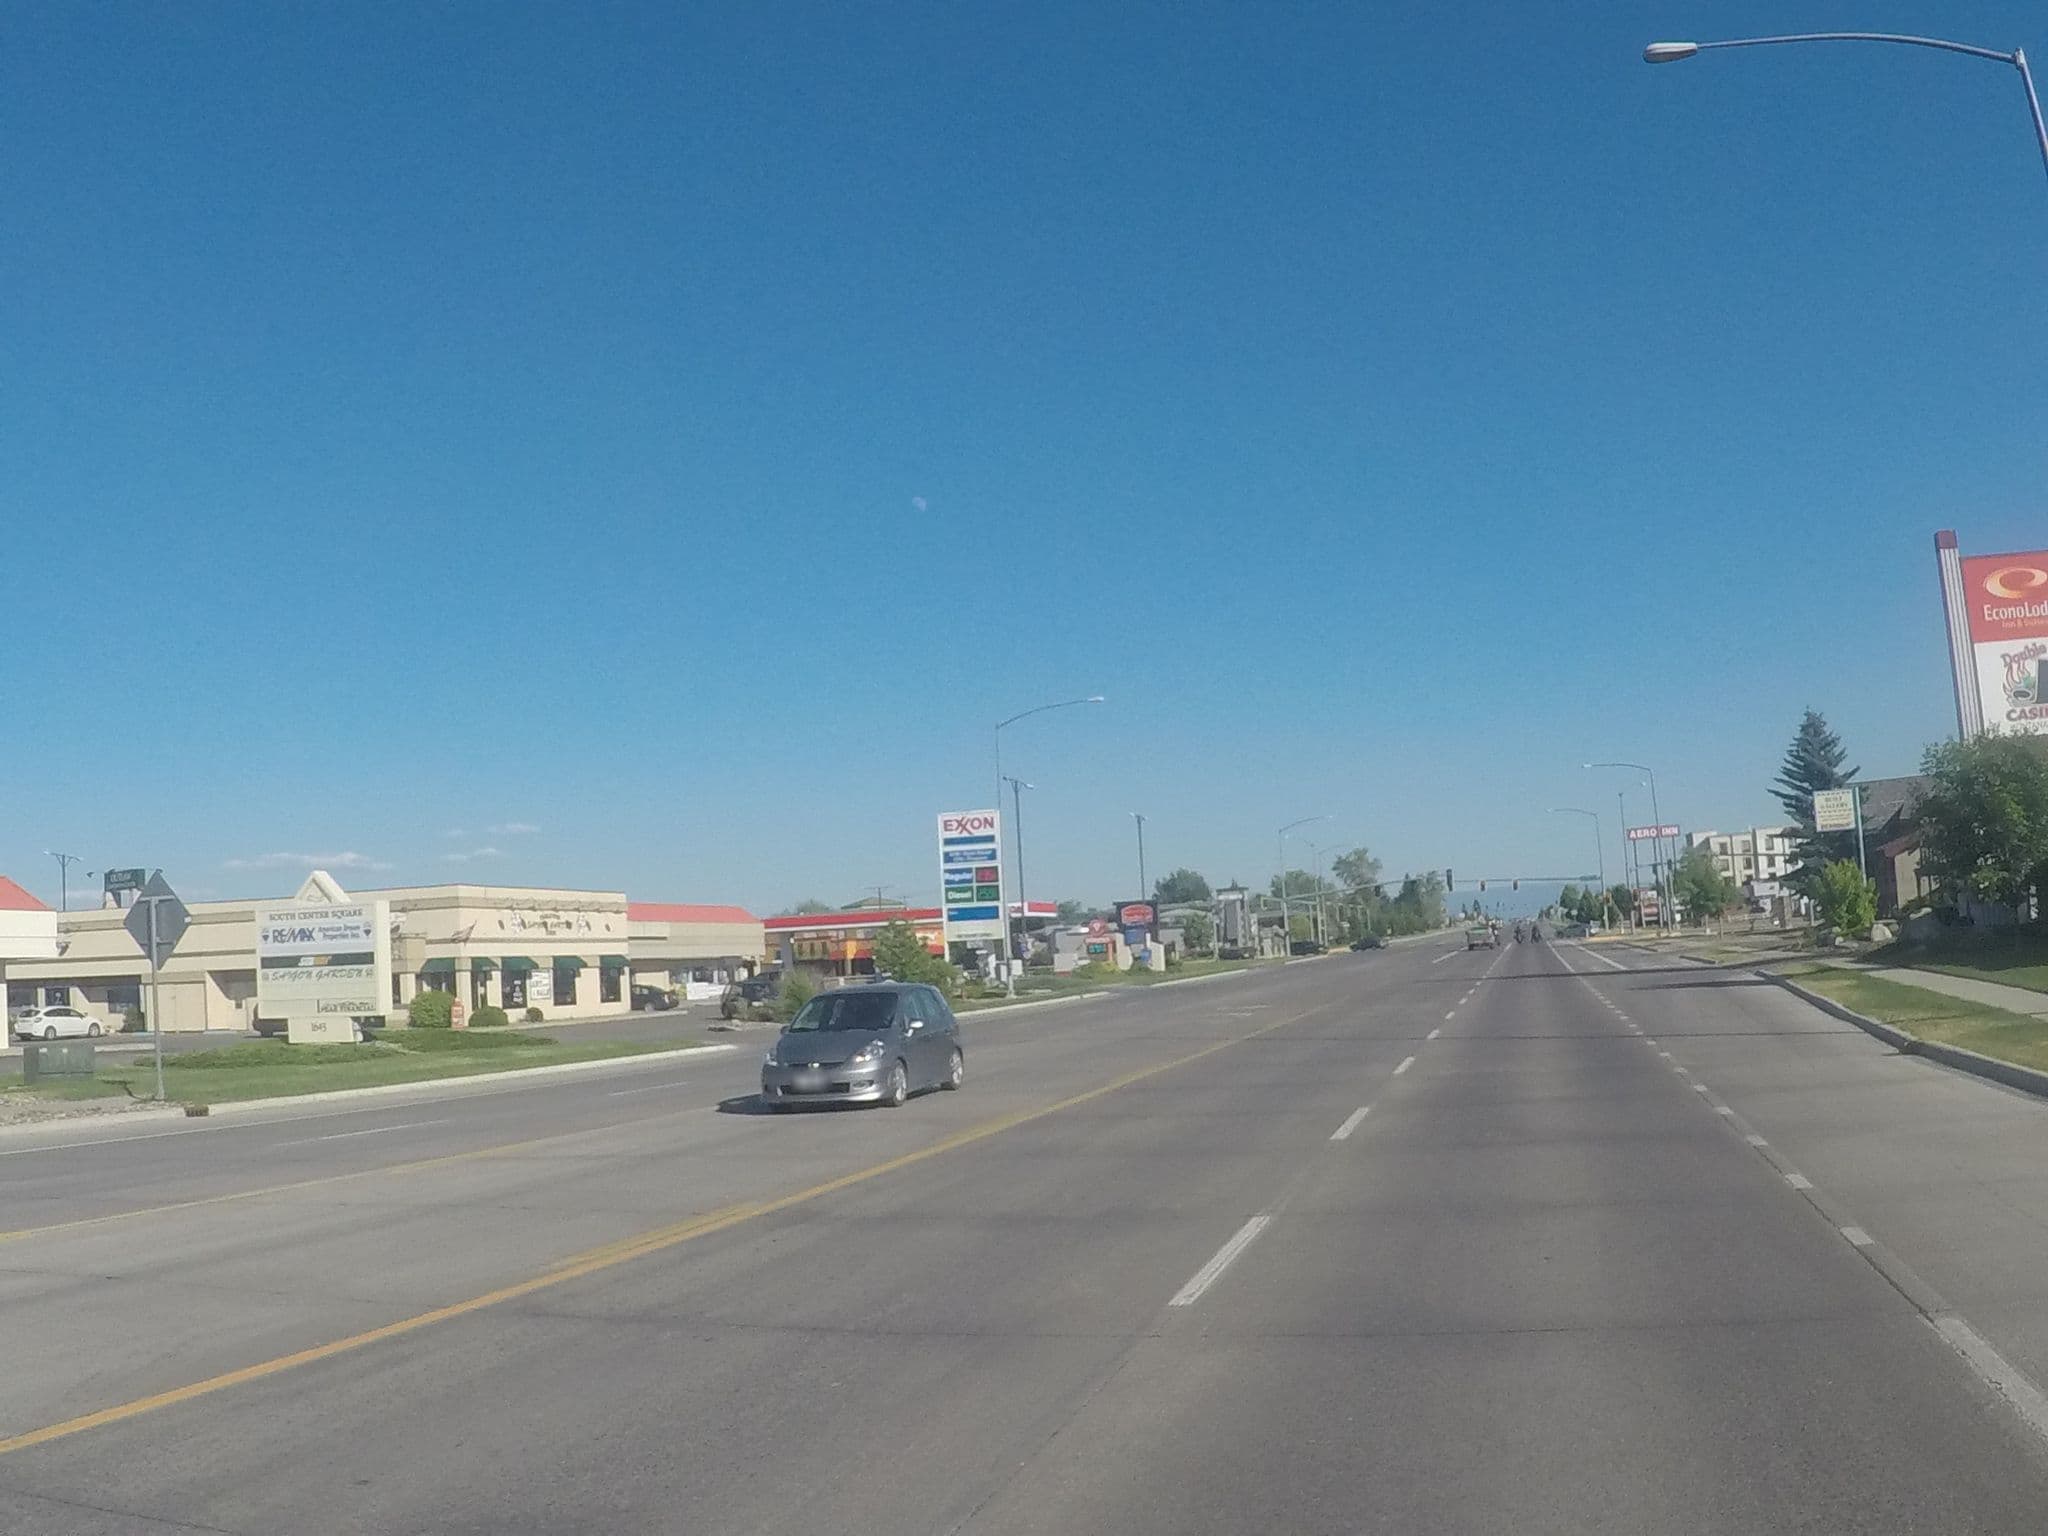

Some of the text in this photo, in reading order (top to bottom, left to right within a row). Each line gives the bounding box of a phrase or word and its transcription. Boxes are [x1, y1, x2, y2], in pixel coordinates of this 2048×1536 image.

[2000, 643, 2047, 667] Double
[943, 816, 994, 835] EXXON
[1629, 827, 1678, 838] AERO INN
[269, 908, 363, 921] SOUTH CENTER SQUARE
[272, 927, 316, 944] RE/MAX
[315, 968, 362, 981] GARDEN
